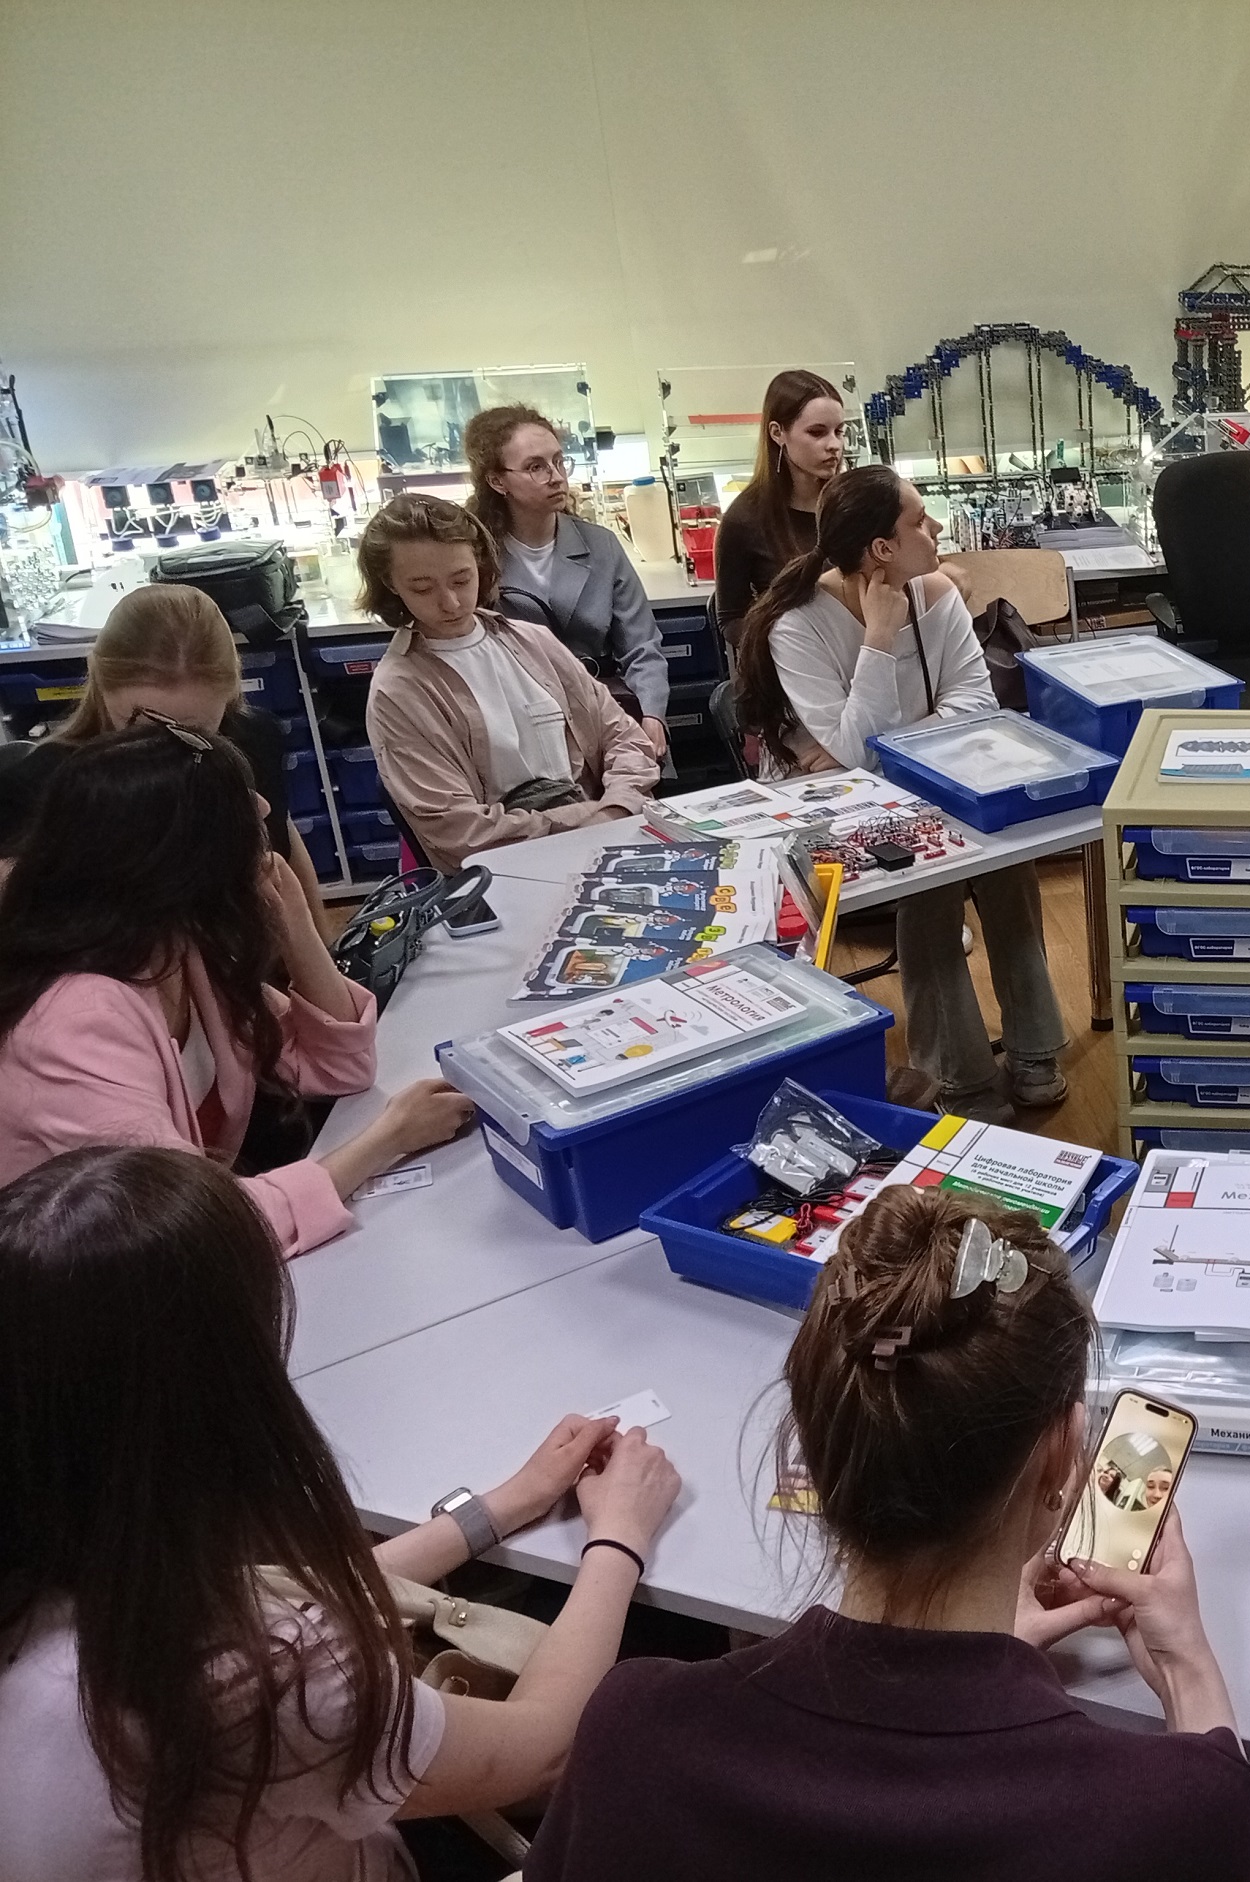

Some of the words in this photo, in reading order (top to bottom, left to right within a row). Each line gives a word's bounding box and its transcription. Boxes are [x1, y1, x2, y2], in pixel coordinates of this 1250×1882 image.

[706, 984, 766, 1021] Метрология
[971, 1162, 988, 1170] для
[988, 1167, 1034, 1183] начальной
[1034, 1179, 1065, 1192] школы
[973, 1154, 1017, 1171] Цифровая
[1017, 1166, 1073, 1185] лаборатория
[1021, 1188, 1045, 1198] учителя)
